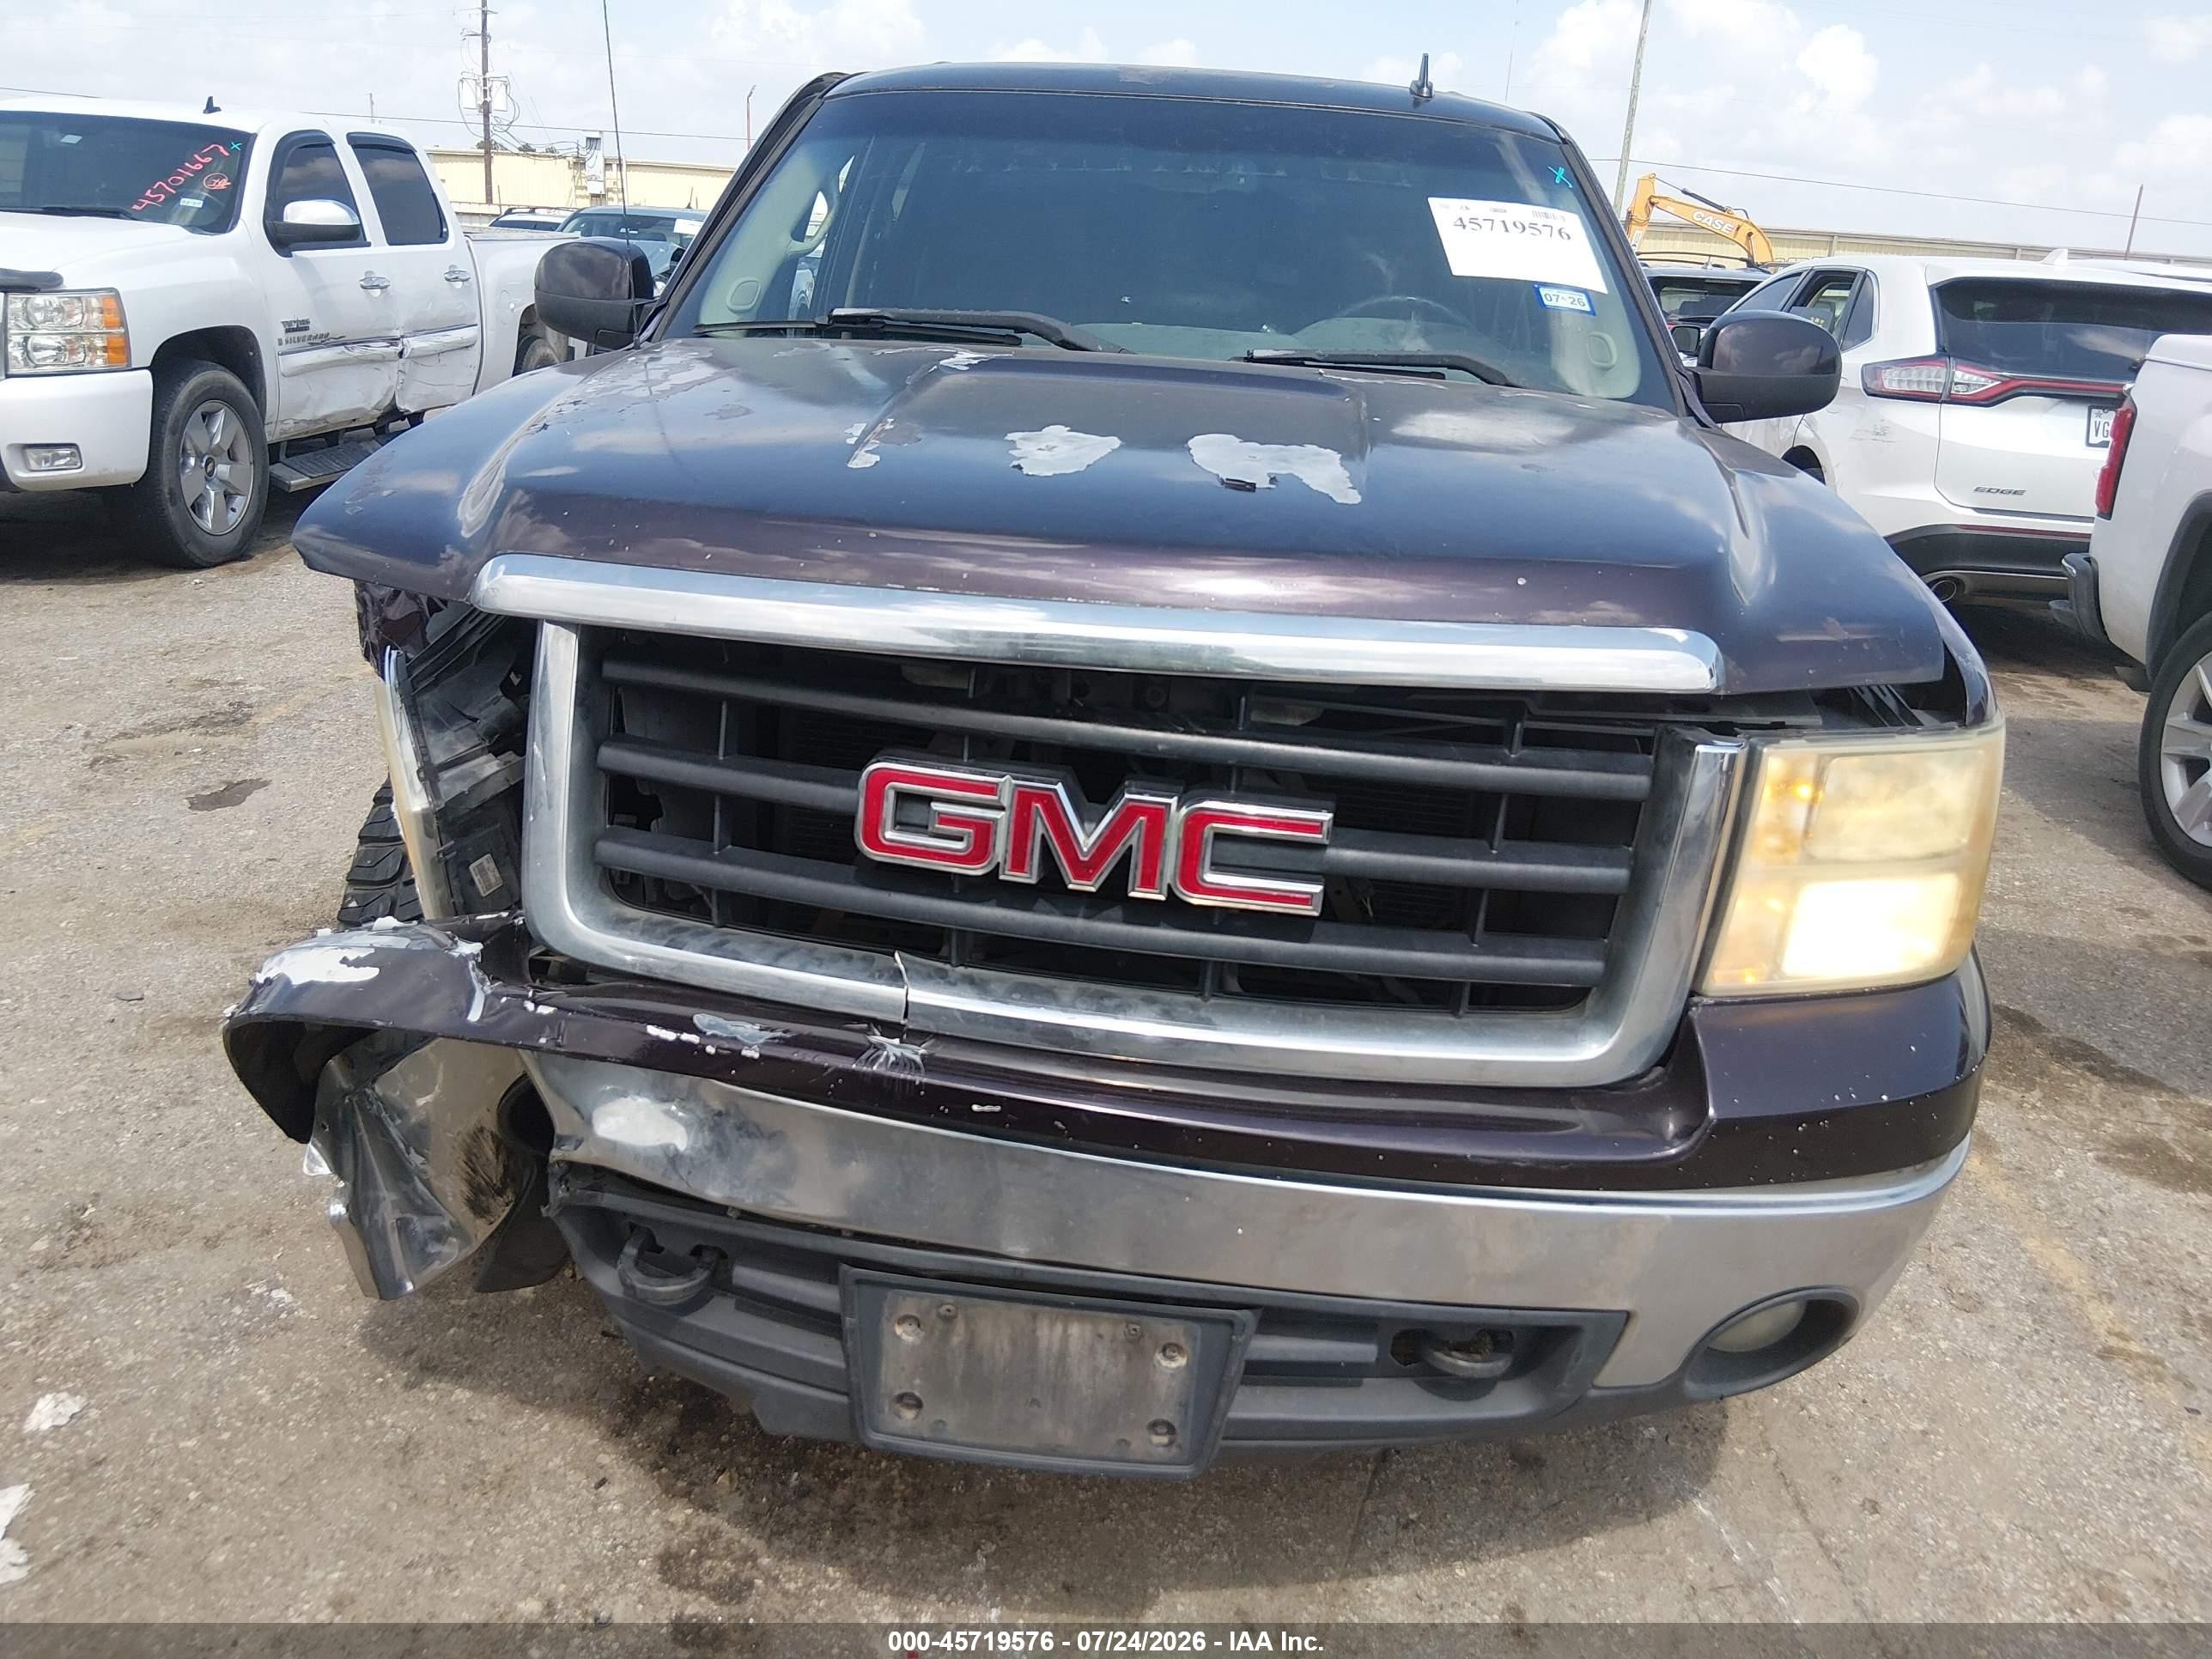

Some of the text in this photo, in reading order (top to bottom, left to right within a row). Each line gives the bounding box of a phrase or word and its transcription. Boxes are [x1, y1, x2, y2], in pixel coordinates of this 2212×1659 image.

[1453, 216, 1571, 241] 45719576
[1692, 210, 1735, 234] CASE
[1974, 486, 2027, 495] EDGE
[854, 761, 1335, 917] GMC
